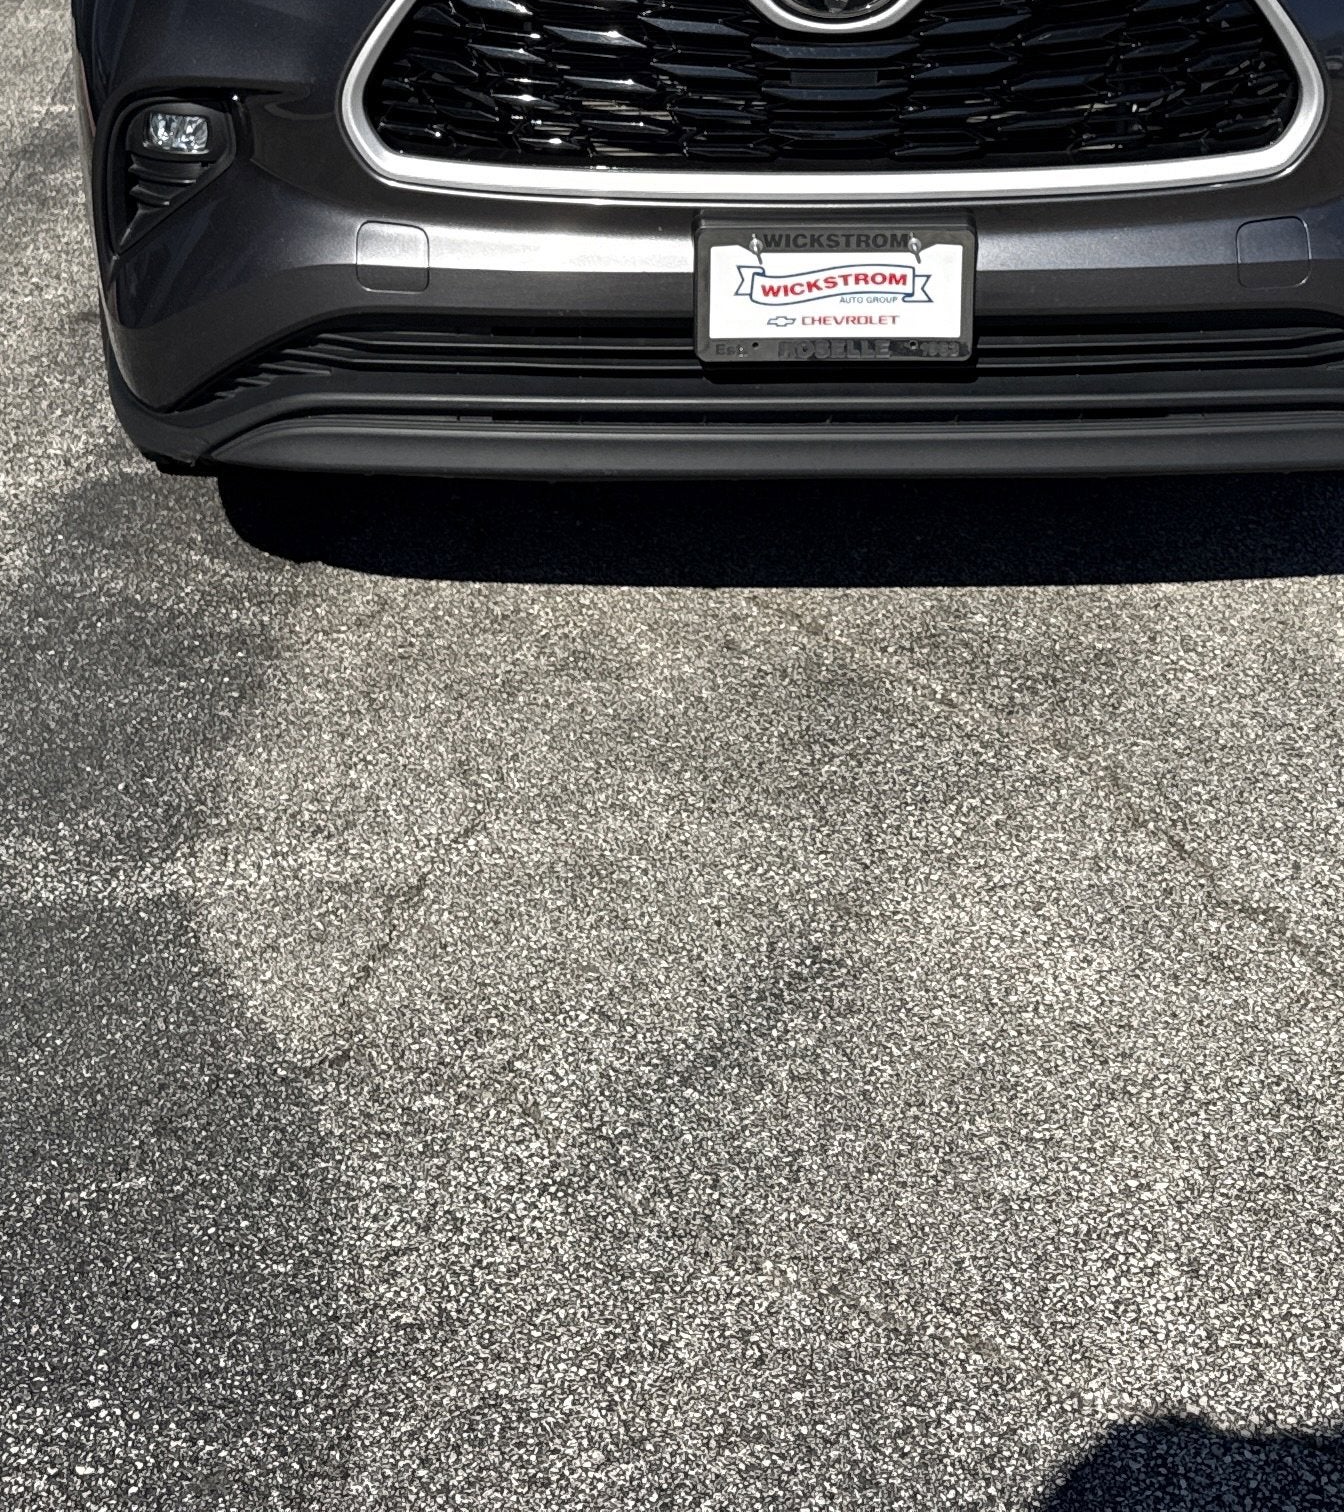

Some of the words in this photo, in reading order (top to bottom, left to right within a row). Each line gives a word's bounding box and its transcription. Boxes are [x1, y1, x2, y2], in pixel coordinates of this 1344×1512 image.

[763, 233, 909, 249] WICKSTROM
[761, 272, 908, 298] WICKSTROM
[839, 296, 864, 304] AUTO
[866, 296, 898, 304] GROUP
[801, 315, 900, 326] CHEVROLET
[777, 339, 891, 358] ROSELLE
